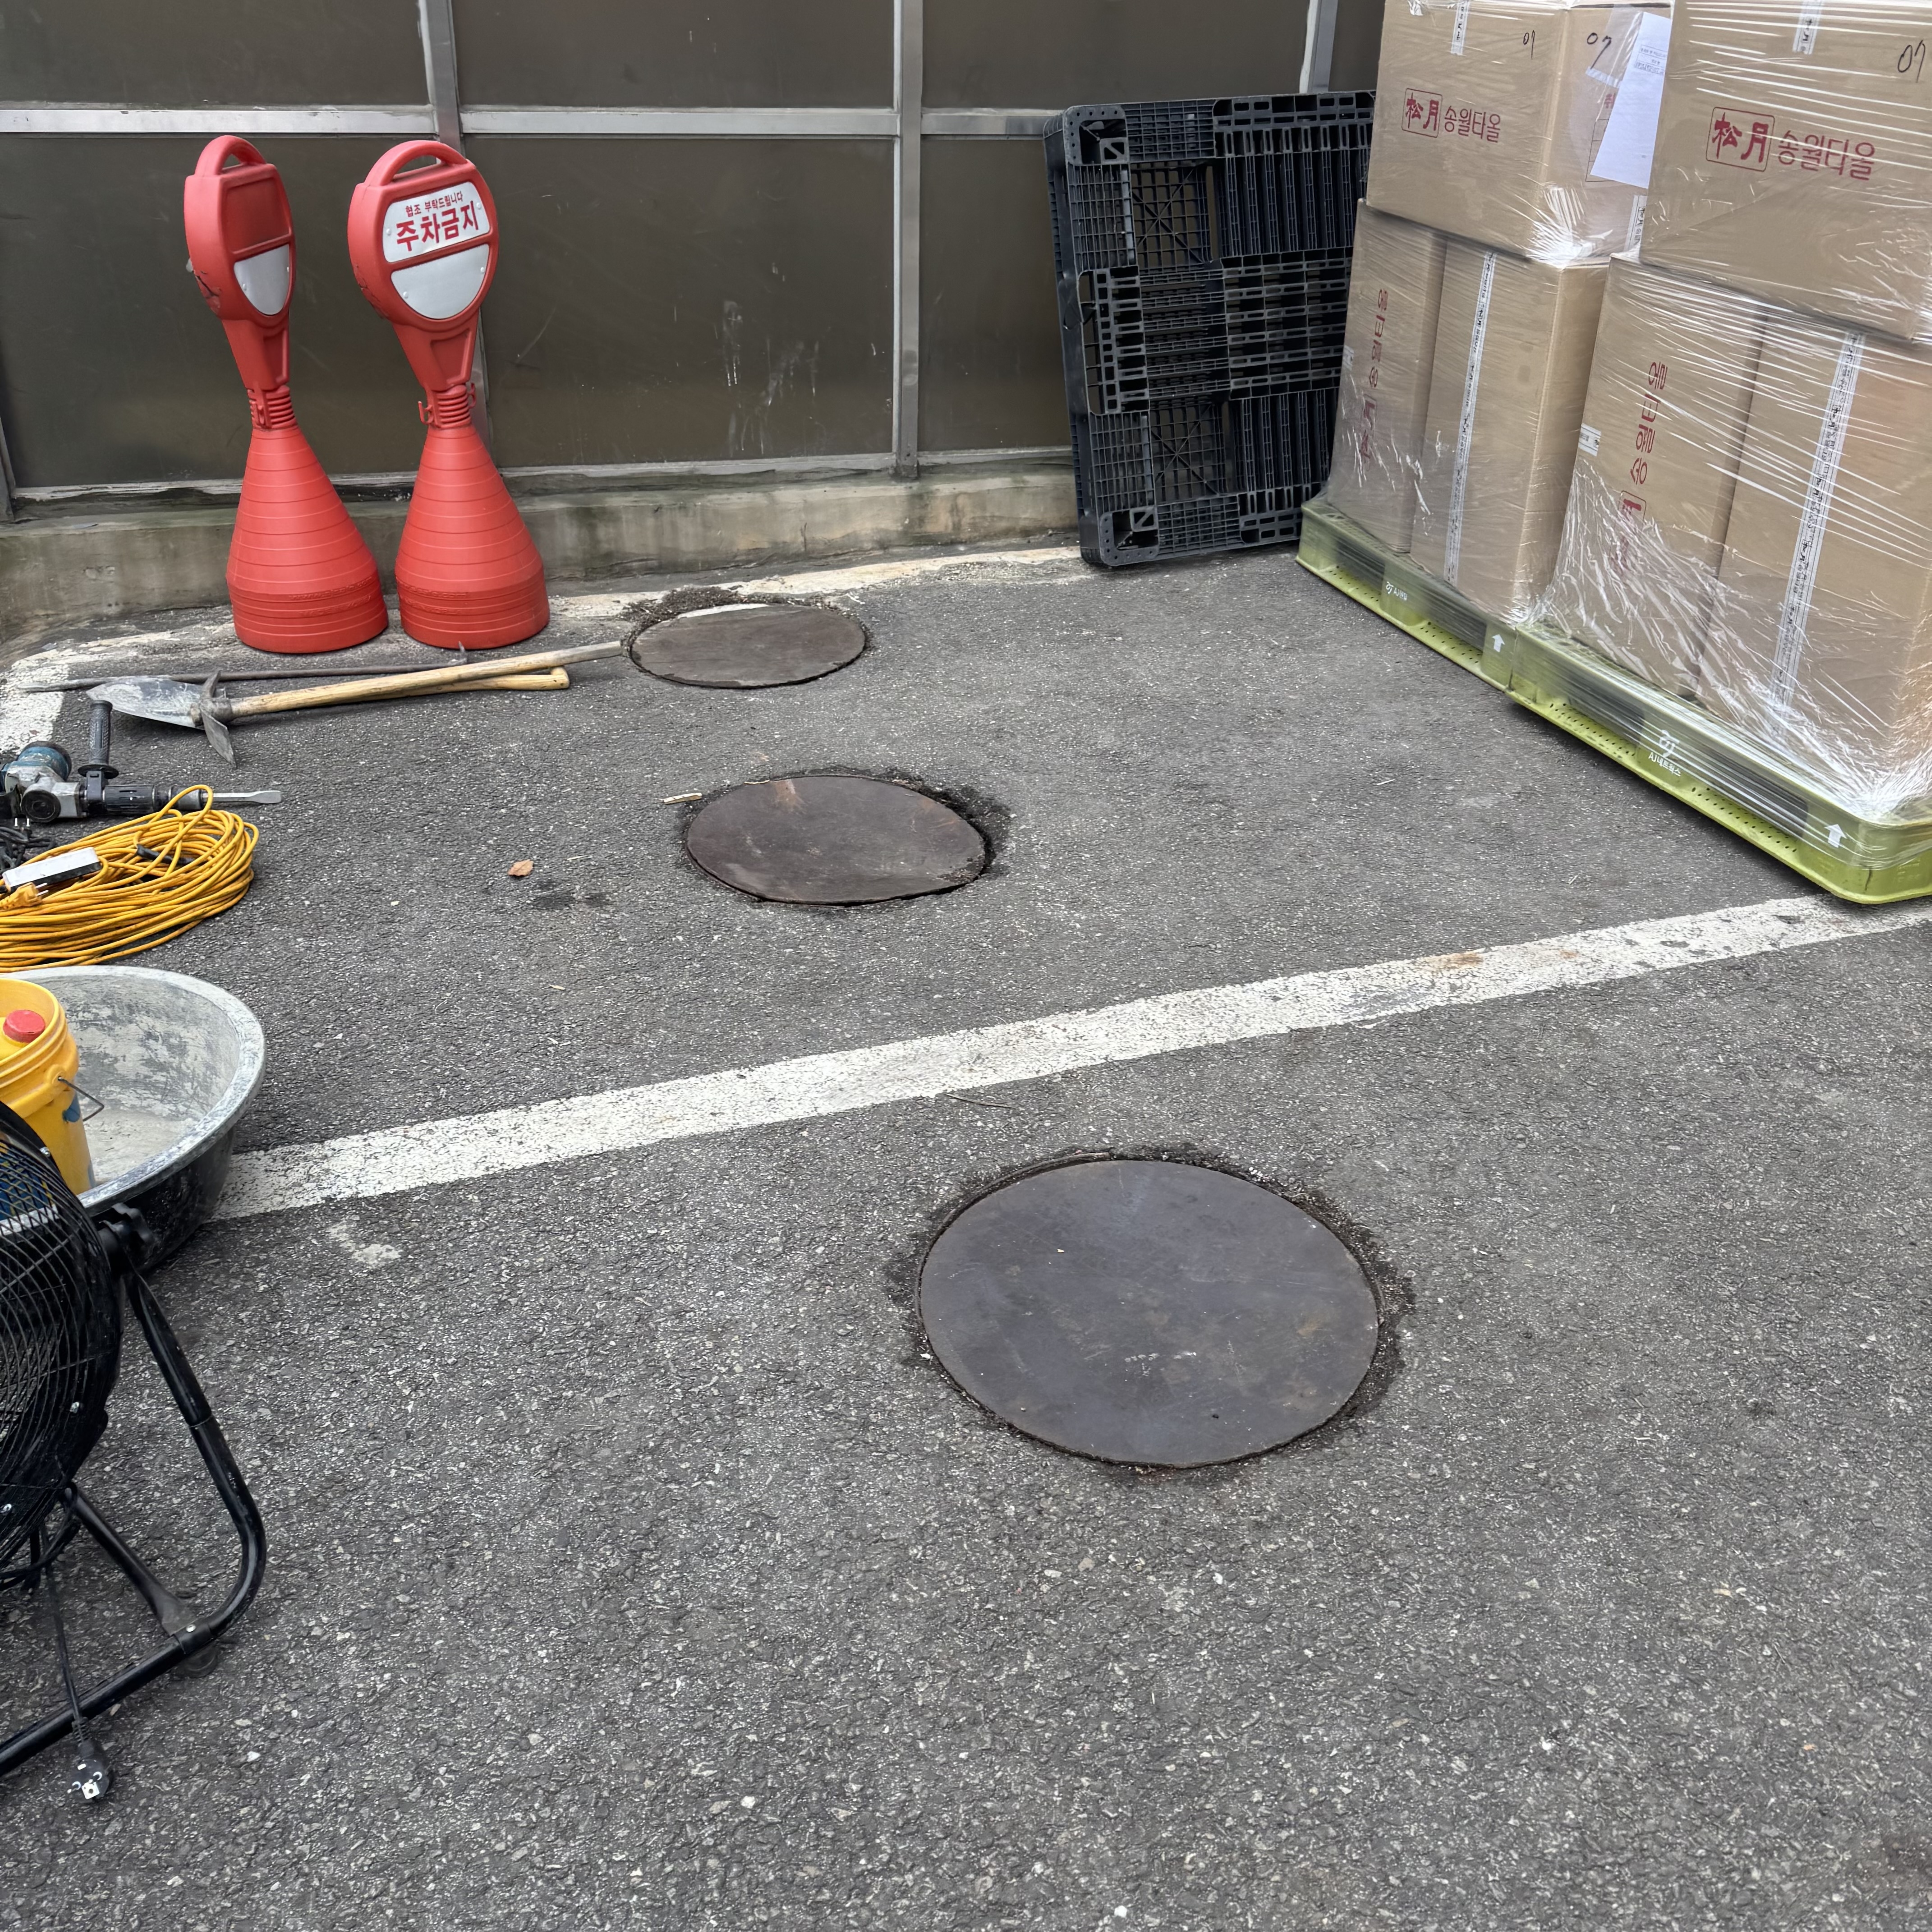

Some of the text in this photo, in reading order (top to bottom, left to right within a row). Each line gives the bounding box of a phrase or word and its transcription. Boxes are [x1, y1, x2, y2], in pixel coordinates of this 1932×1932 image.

[1587, 32, 1612, 69] 07
[1897, 40, 1926, 83] 07
[1405, 92, 1501, 143] 松月 송월타올
[1712, 112, 1875, 180] 松月 송월타올
[396, 200, 478, 252] 주차금지
[405, 191, 463, 217] 협조 부탁드립니다
[1630, 361, 1668, 485] 송월타올
